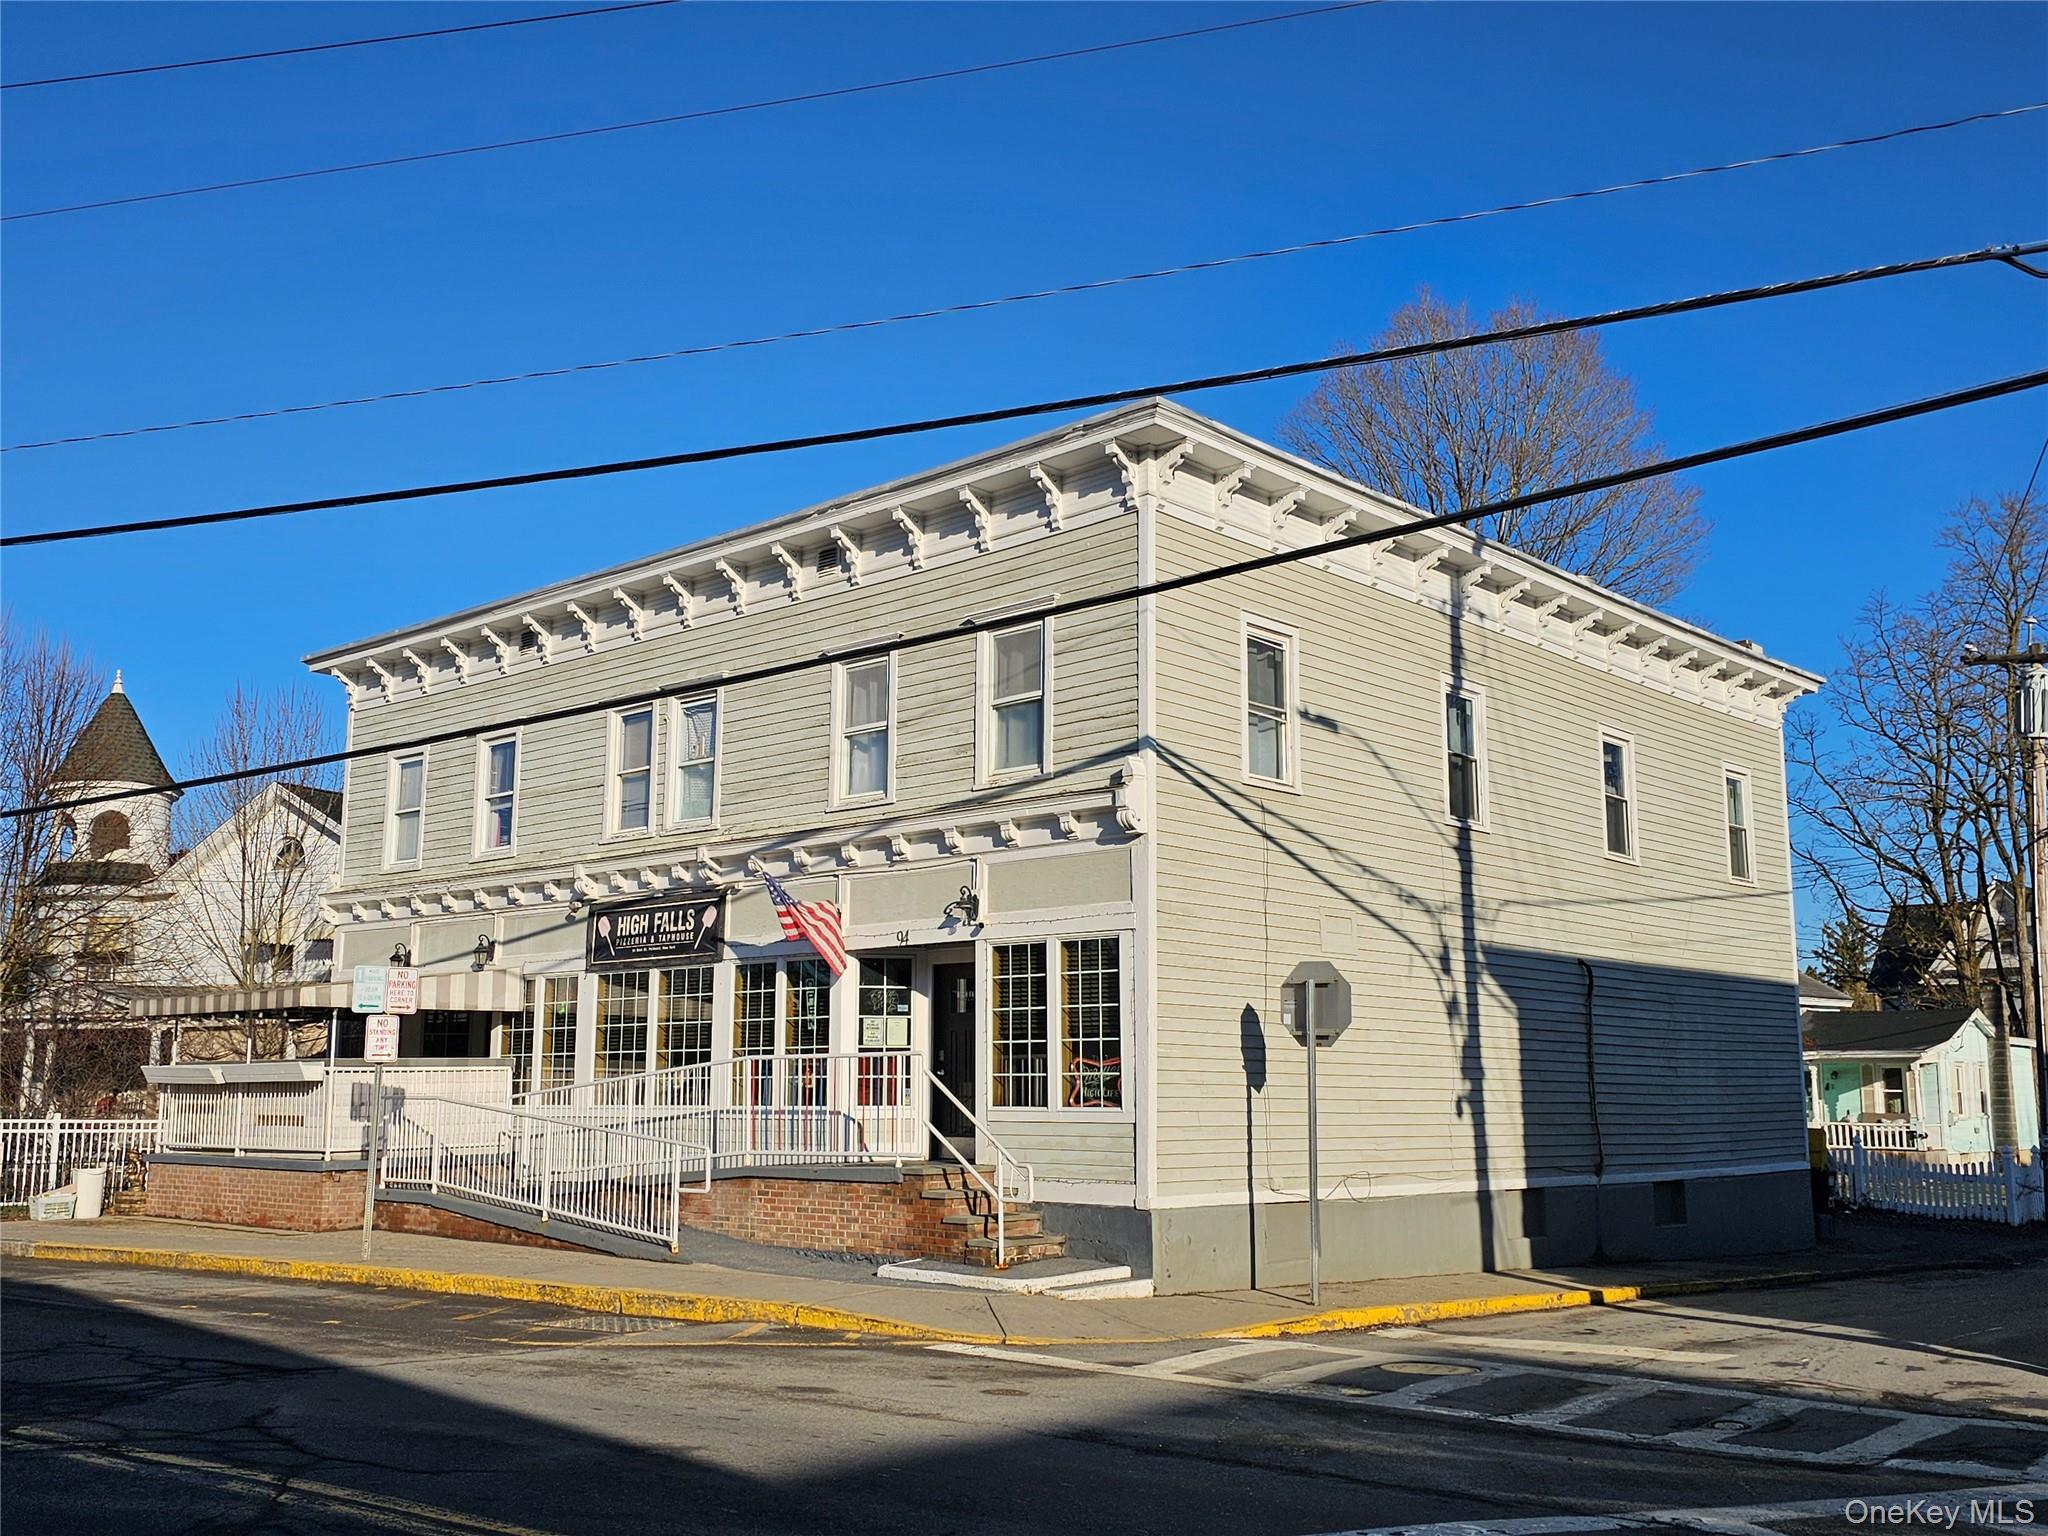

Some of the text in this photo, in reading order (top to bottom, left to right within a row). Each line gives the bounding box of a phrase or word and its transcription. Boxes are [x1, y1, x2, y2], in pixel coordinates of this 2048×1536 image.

[616, 909, 696, 937] HIGH FALLS
[615, 936, 647, 947] PIZZERIA
[658, 931, 695, 943] TAPHOUSE
[896, 929, 910, 947] 94
[397, 971, 409, 979] NO
[388, 981, 416, 990] PARKING
[376, 1019, 389, 1027] NO
